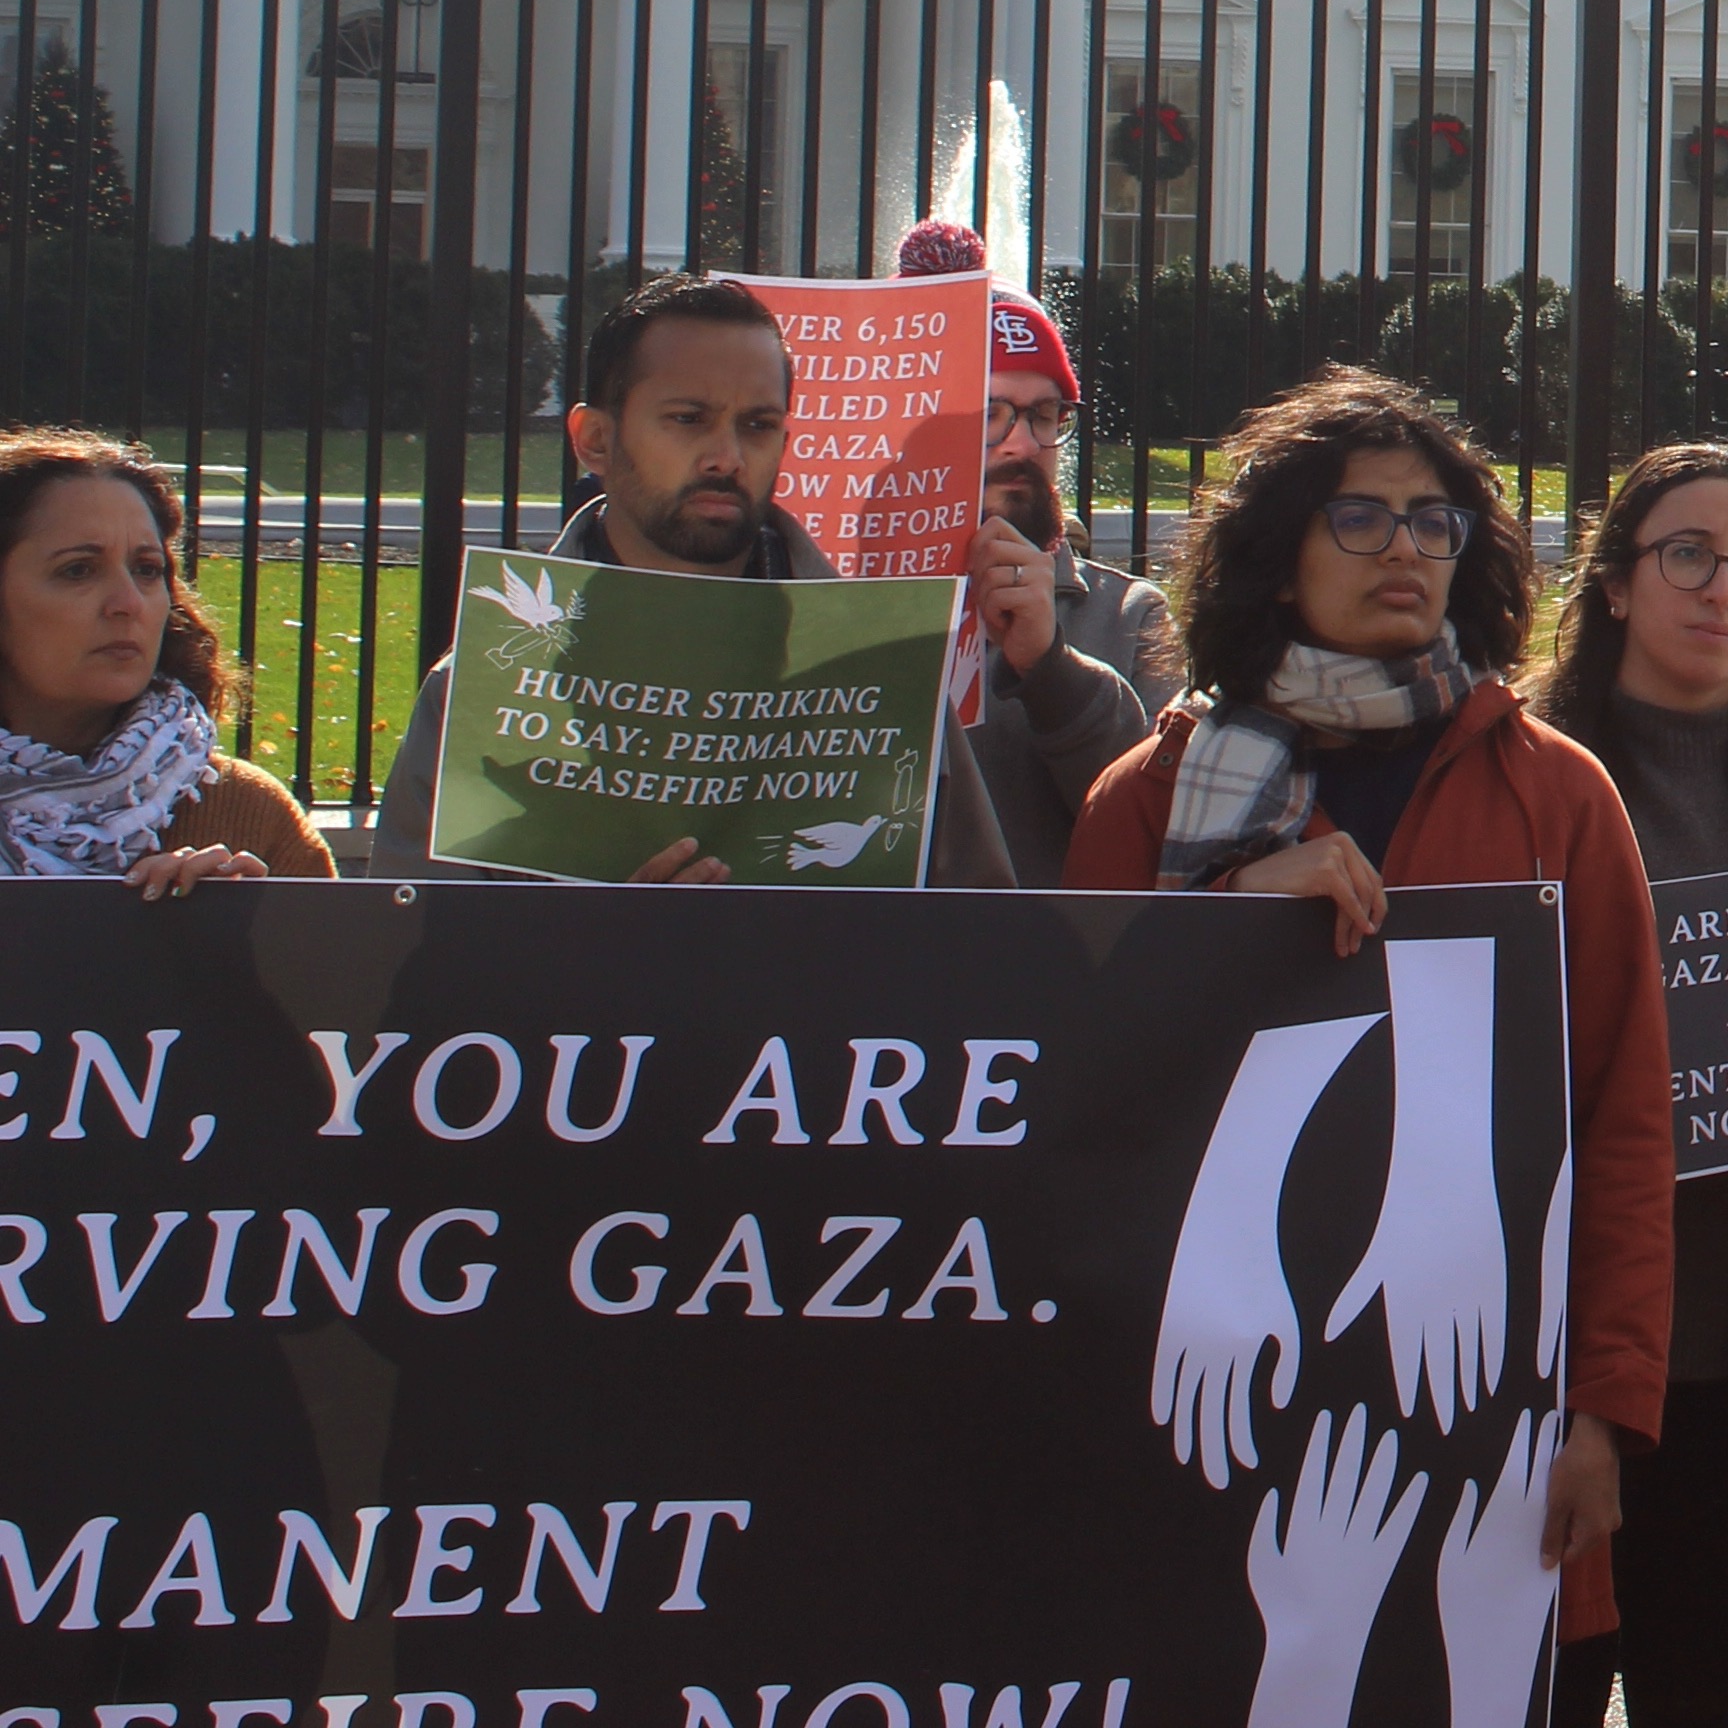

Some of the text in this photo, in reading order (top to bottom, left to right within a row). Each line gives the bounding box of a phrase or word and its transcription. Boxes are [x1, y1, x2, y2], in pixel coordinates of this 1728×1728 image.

[857, 312, 946, 346] 6,150
[788, 389, 943, 421] LLED IN
[792, 434, 905, 463] GAZA,
[843, 466, 951, 499] MANY
[837, 501, 968, 540] BEFORE
[826, 543, 953, 576] EFIRE?
[514, 667, 881, 720] HUNGER STRIKING
[495, 706, 901, 763] TO SAY: PERMANENT
[528, 757, 858, 805] CEASEFIRE NOW!
[308, 1031, 656, 1142] YOU
[702, 1035, 1040, 1147] ARE
[569, 1210, 1058, 1324] GAZA.
[0, 1499, 752, 1631] MANENT
